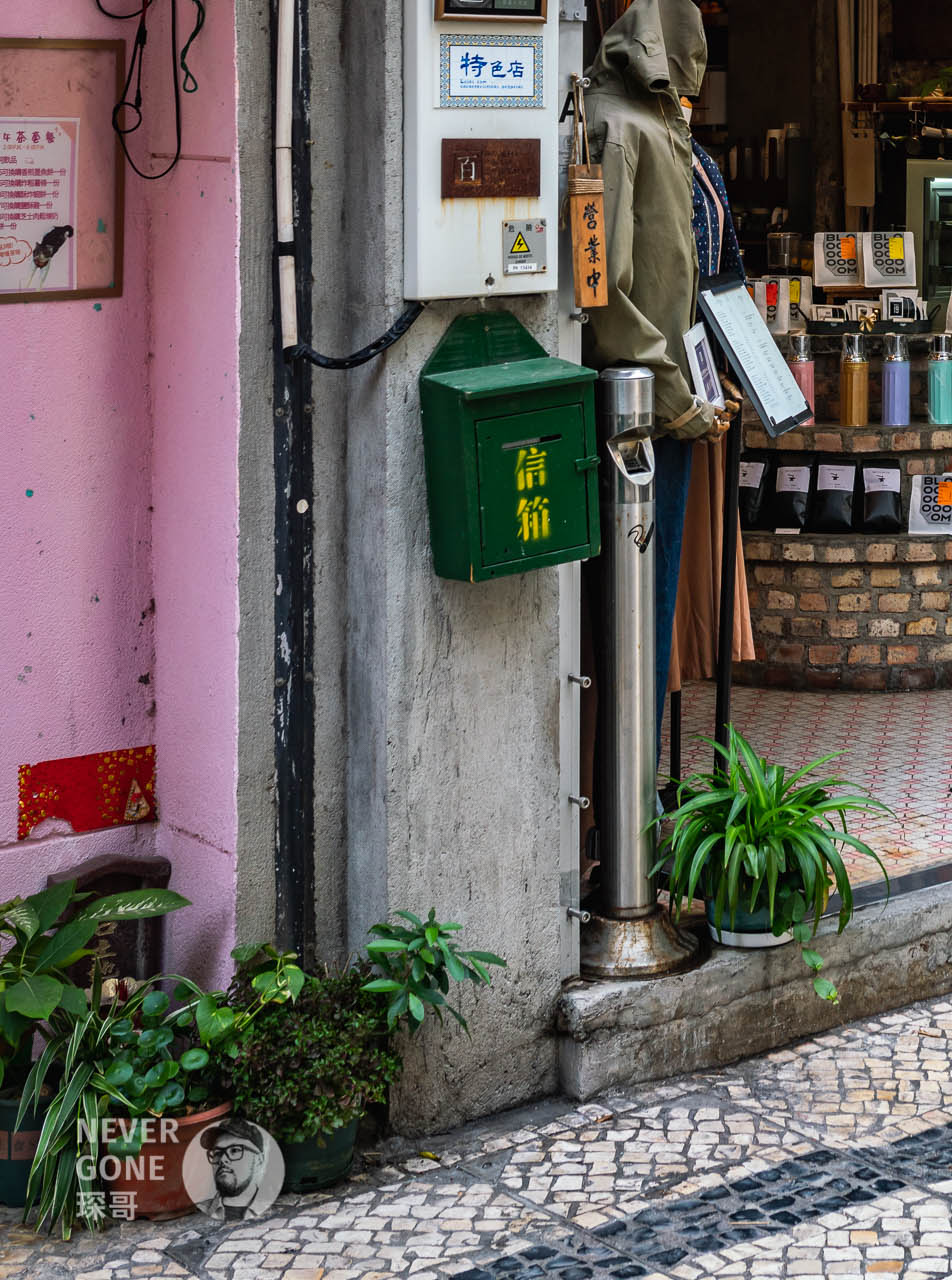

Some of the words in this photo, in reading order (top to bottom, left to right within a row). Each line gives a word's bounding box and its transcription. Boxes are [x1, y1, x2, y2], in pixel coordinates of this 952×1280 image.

[460, 52, 524, 78] 特色店
[583, 202, 601, 298] 營業中
[885, 266, 906, 274] OM
[515, 447, 550, 542] 信箱
